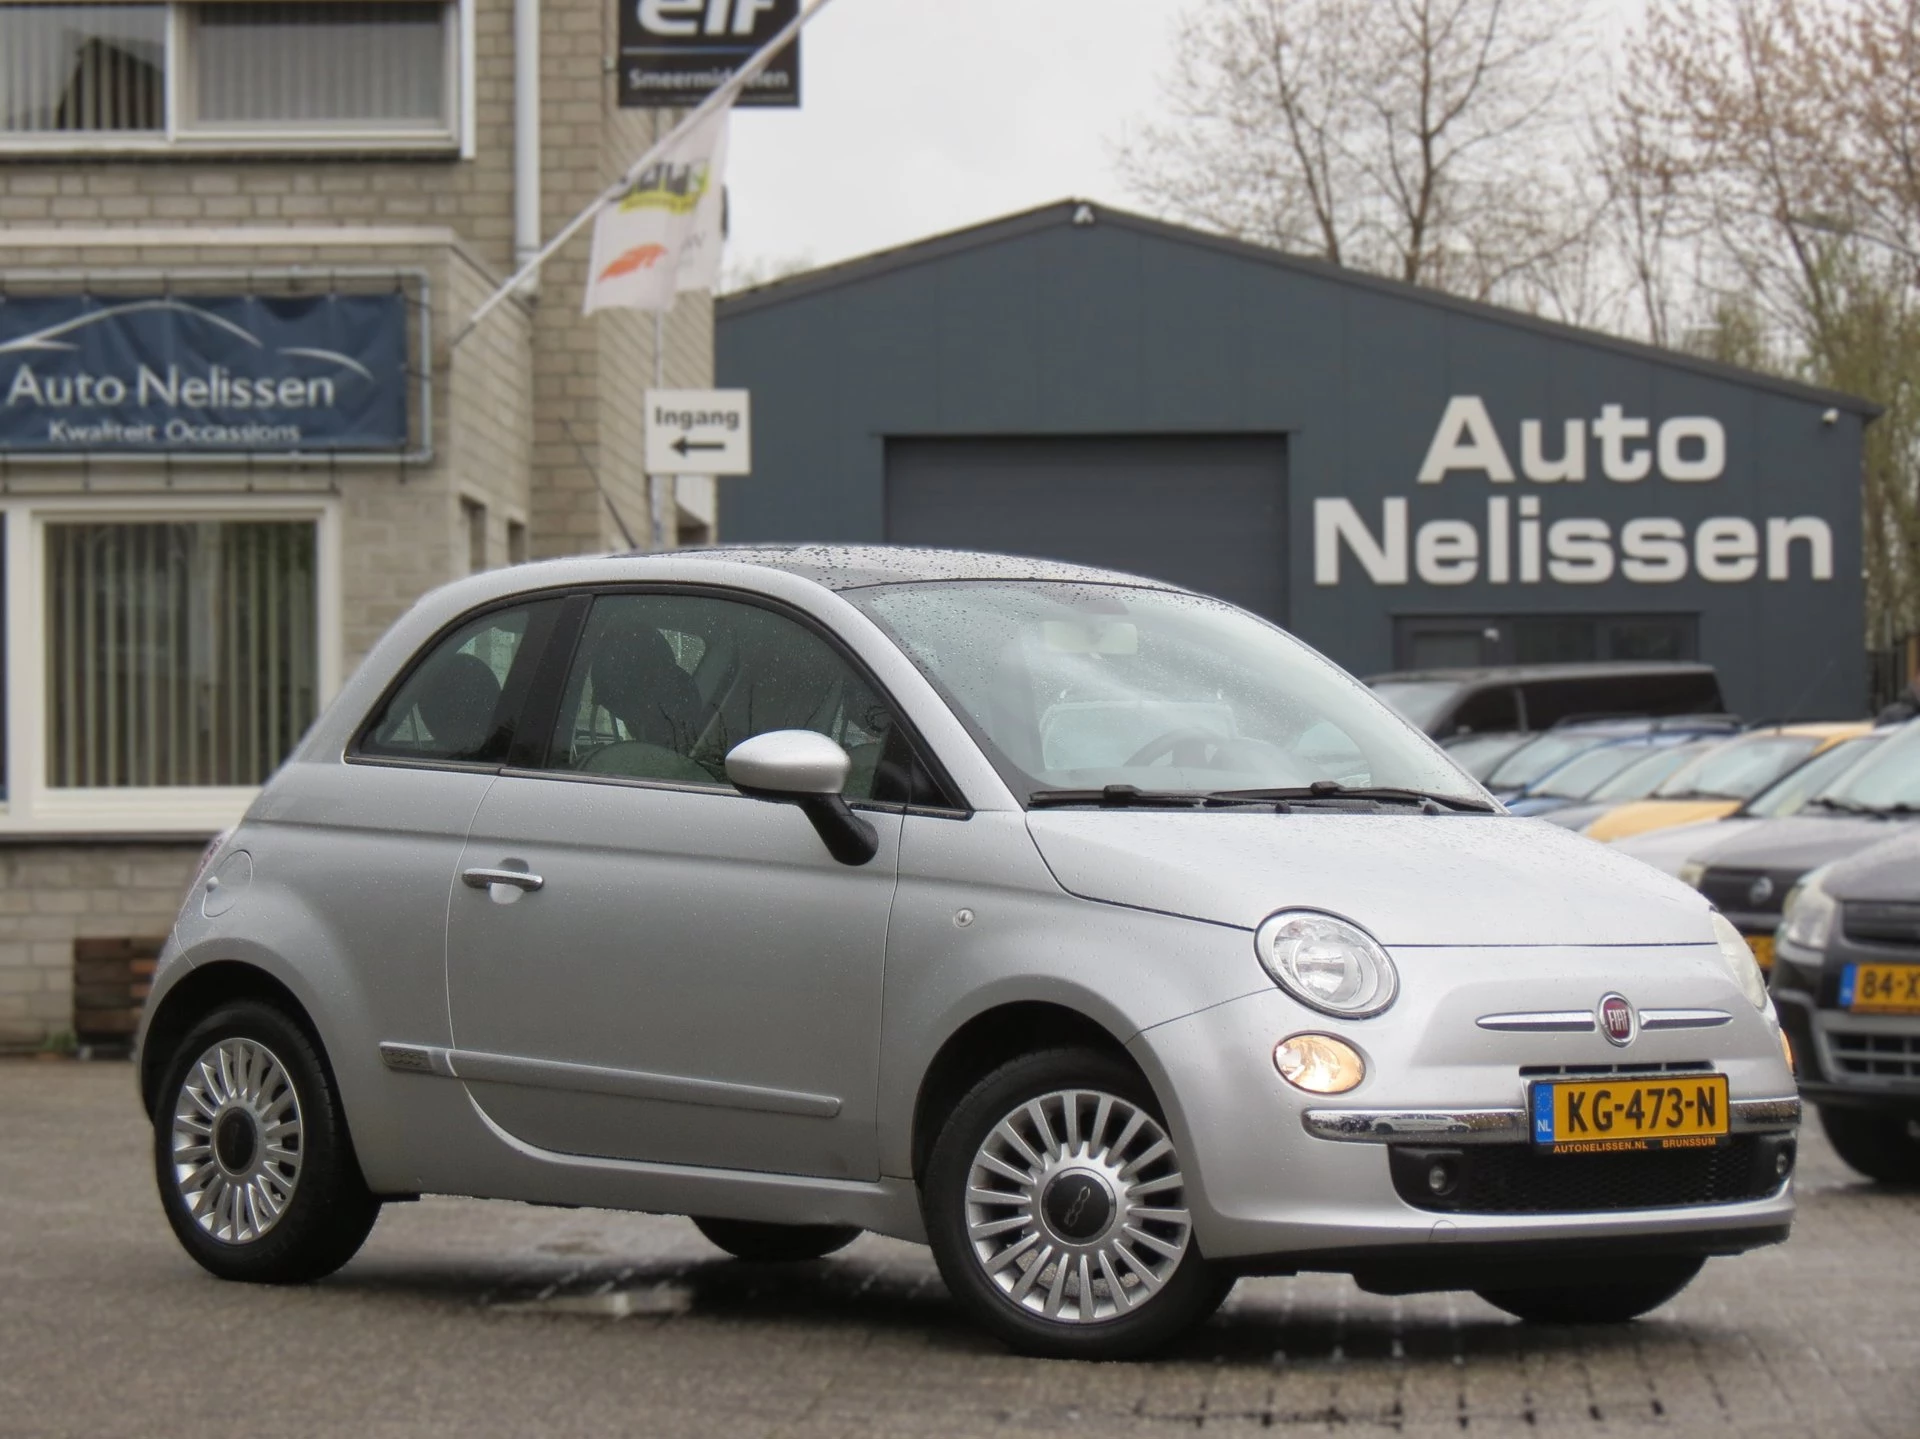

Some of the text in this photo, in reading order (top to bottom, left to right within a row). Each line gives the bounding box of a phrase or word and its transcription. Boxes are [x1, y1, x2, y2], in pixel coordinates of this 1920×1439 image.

[637, 0, 775, 36] elf
[7, 363, 335, 408] Auto Nelissen
[49, 418, 300, 443] Kwaliteit Occassions
[655, 405, 740, 431] Ingang
[1416, 395, 1726, 483] Auto
[1314, 496, 1833, 585] Nelissen
[1607, 1008, 1628, 1031] FIAT
[1567, 1086, 1716, 1133] KG-473-N
[1537, 1119, 1552, 1133] NL
[1553, 1137, 1716, 1154] AUTONELISSEN.NL BRUNSSUM
